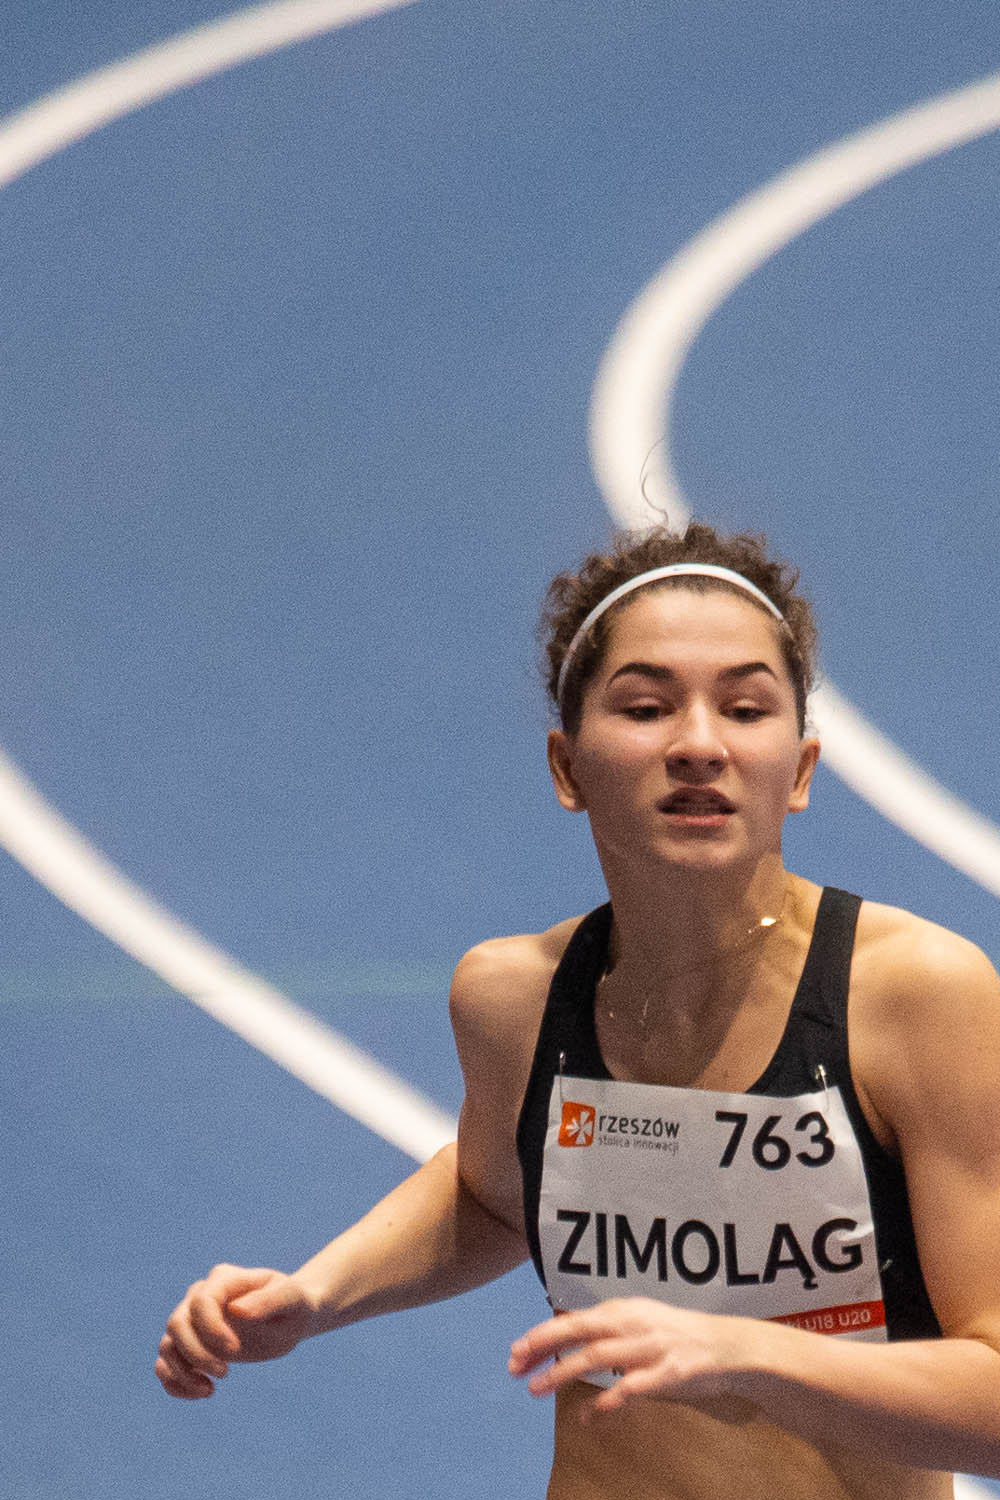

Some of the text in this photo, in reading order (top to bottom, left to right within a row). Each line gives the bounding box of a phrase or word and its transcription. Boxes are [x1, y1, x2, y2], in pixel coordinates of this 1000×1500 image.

[598, 1115, 680, 1138] rzeszów
[715, 1110, 836, 1171] 763
[556, 1209, 864, 1290] ZIMOLĄG
[805, 1314, 834, 1330] U18
[838, 1309, 872, 1326] U20
